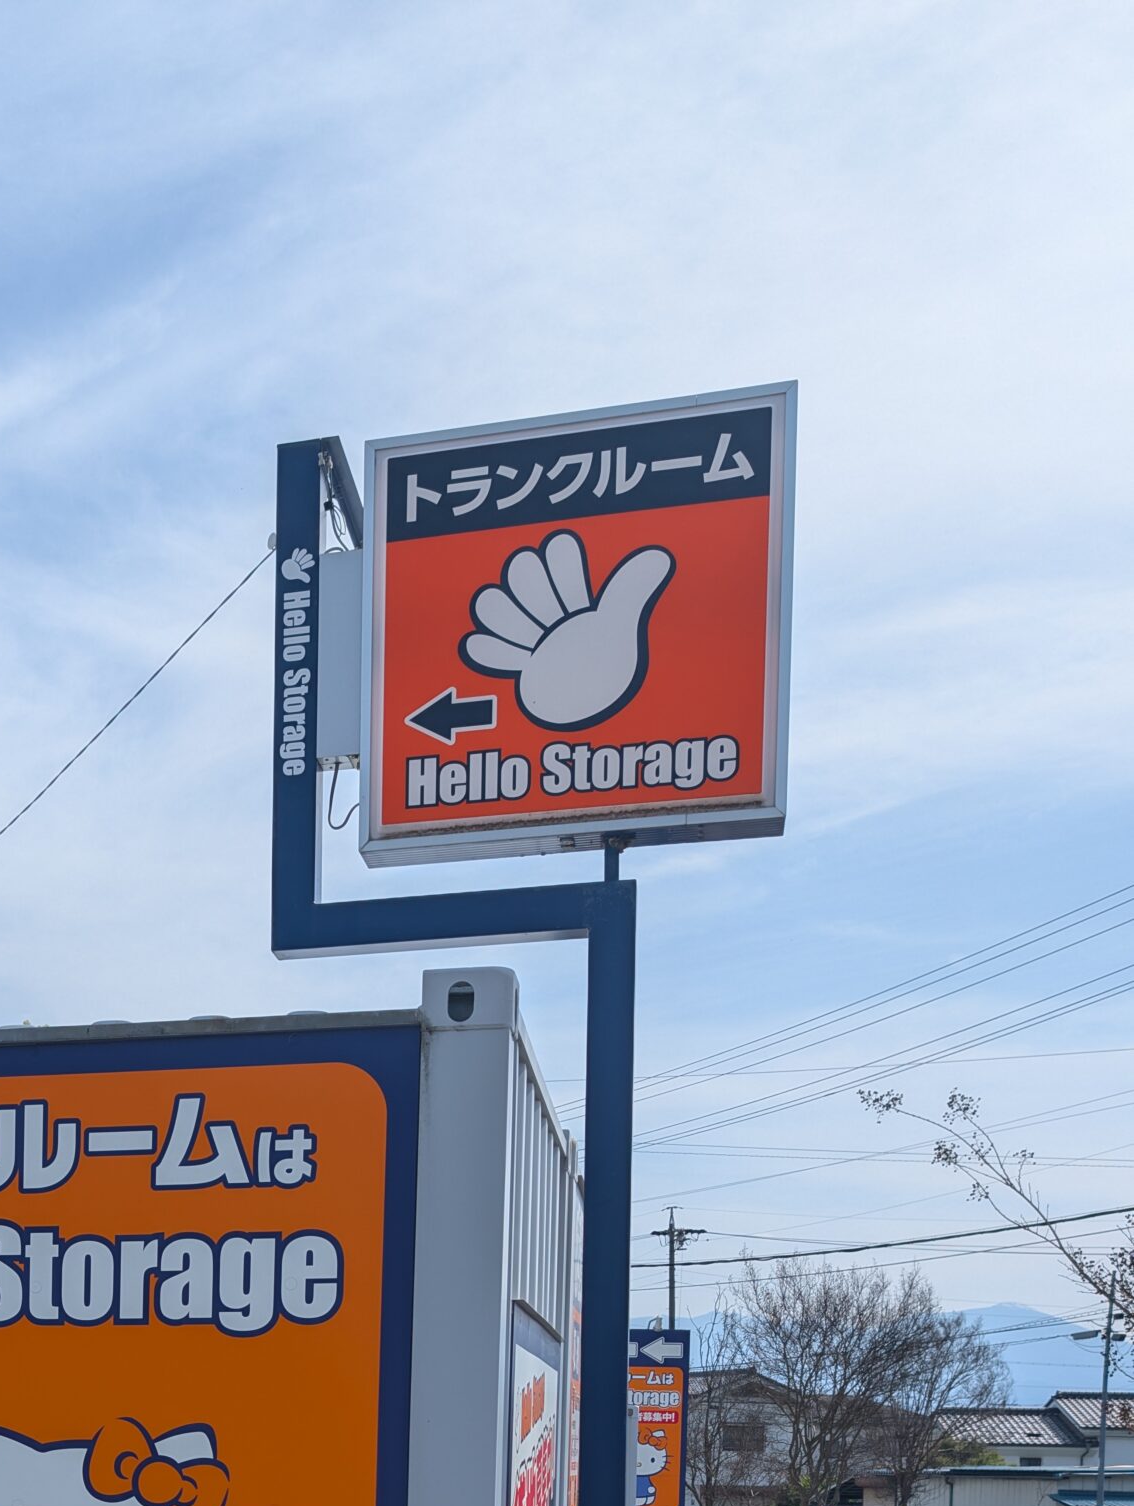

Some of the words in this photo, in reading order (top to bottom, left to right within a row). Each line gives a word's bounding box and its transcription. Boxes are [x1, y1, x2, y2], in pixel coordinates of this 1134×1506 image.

[406, 433, 755, 523] トランクルーム
[282, 589, 311, 663] Hello
[280, 667, 312, 777] Storage
[405, 750, 531, 809] Hello
[540, 735, 739, 796] Storage
[627, 1390, 680, 1407] torage
[628, 1370, 674, 1385] ームは
